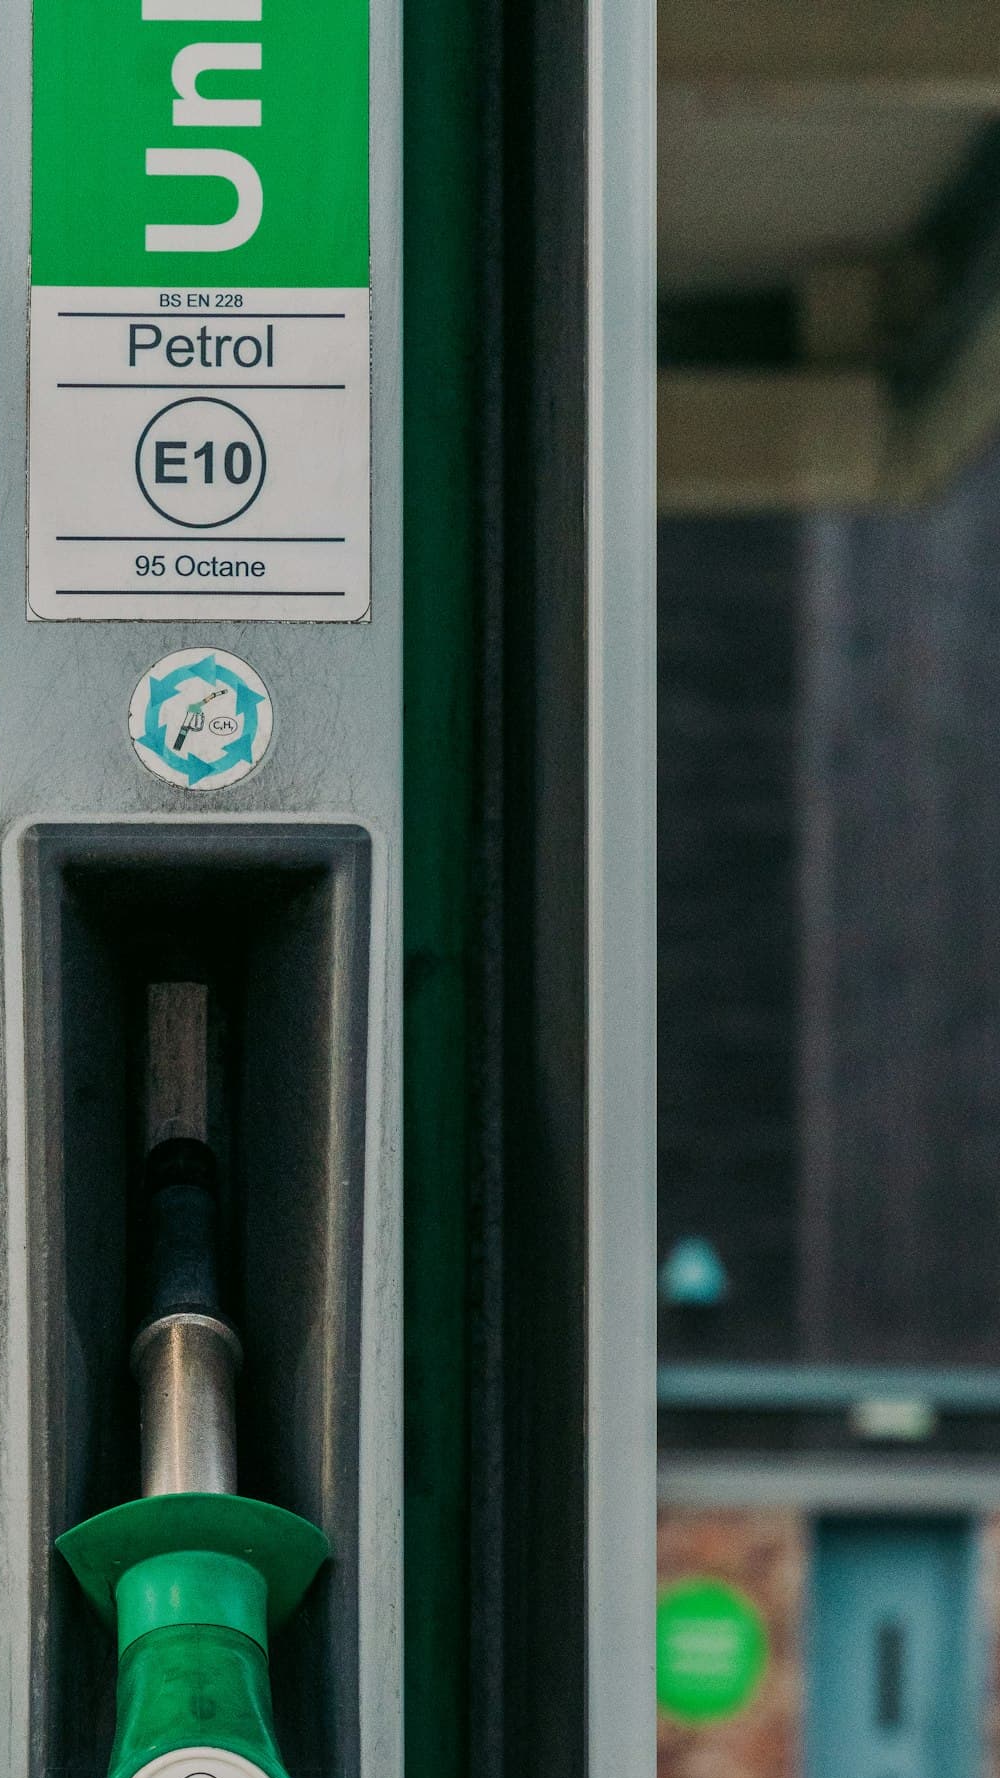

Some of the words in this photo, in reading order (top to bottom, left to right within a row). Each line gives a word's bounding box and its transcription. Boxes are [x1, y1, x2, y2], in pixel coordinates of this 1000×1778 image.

[160, 294, 181, 307] BS
[188, 294, 209, 307] EN
[216, 295, 243, 307] 228
[130, 324, 273, 367] Petrol
[154, 441, 253, 485] E10
[136, 556, 165, 576] 95
[176, 555, 265, 576] Octane
